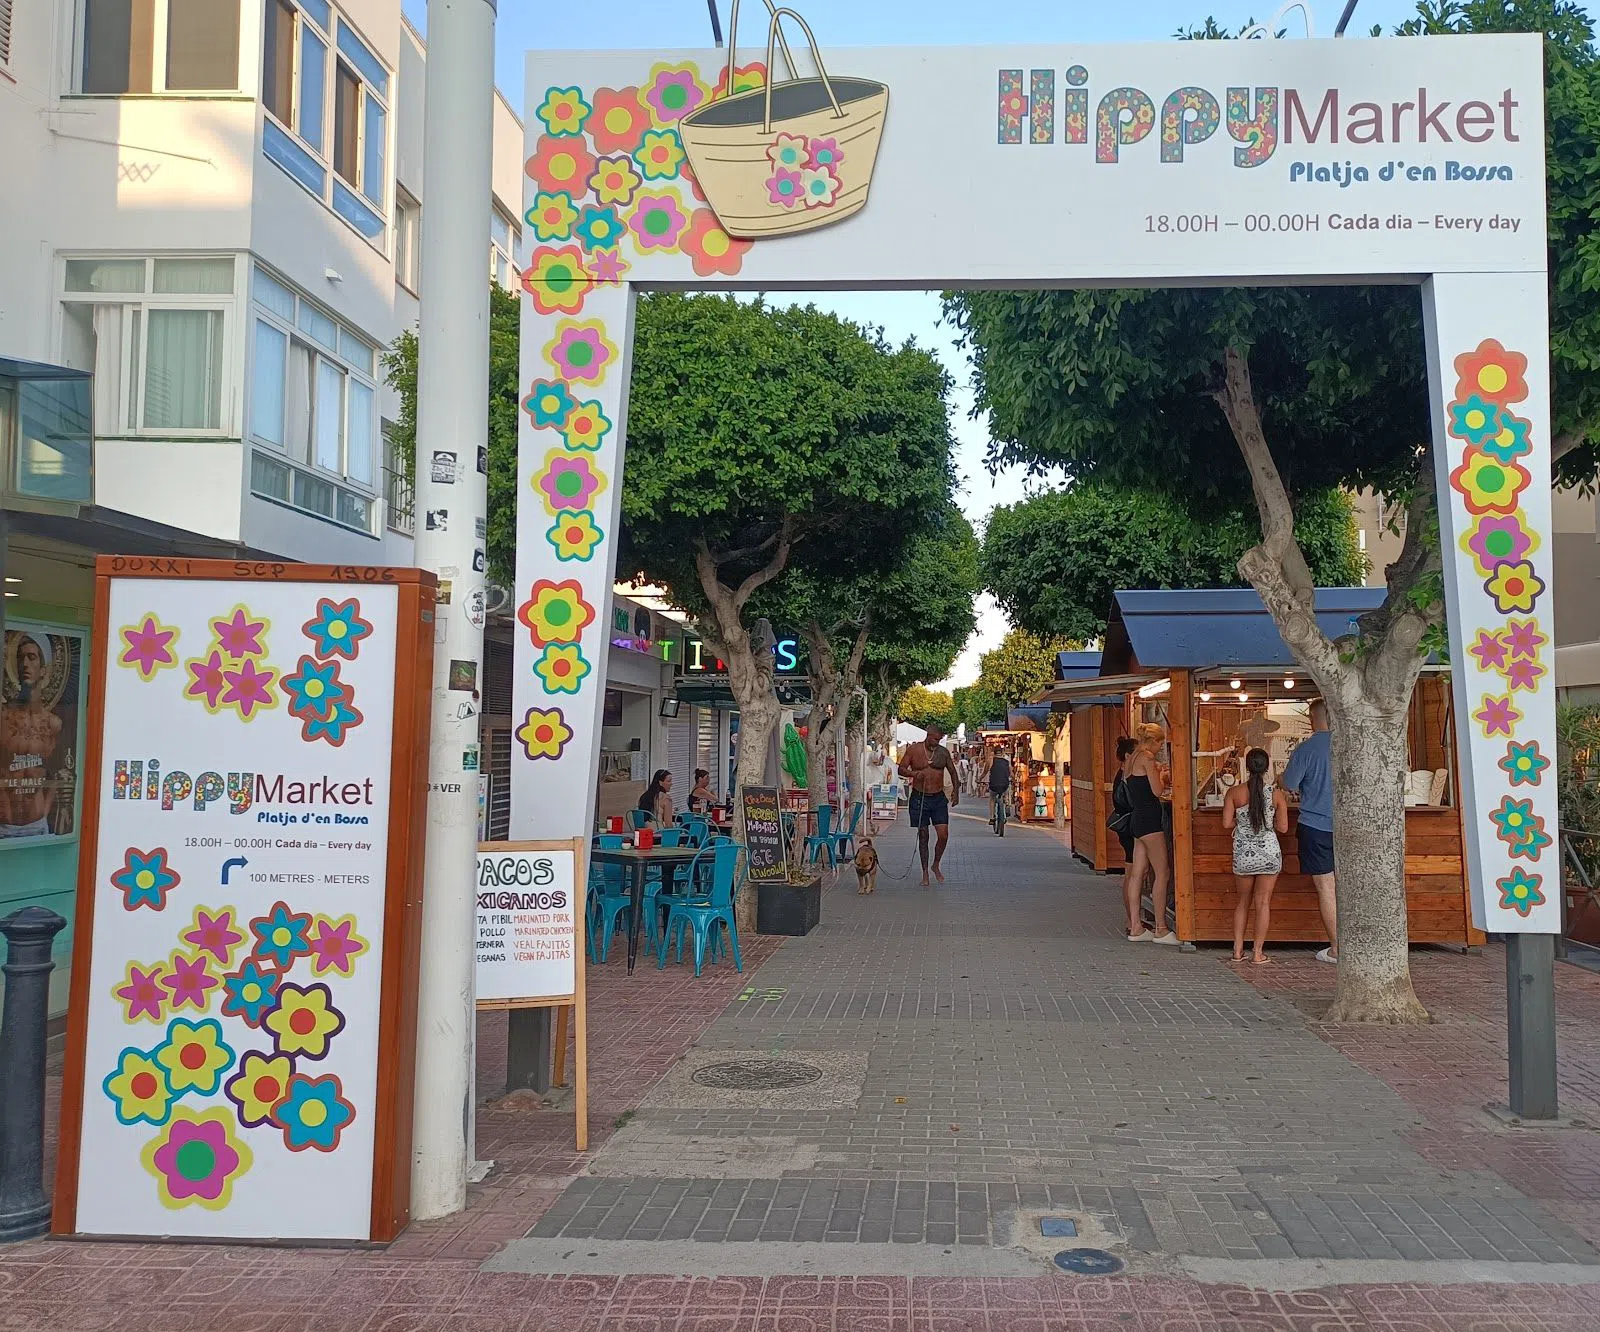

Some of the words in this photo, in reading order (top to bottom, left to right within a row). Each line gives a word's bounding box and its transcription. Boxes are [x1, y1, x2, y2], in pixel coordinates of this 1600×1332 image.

[1289, 161, 1369, 188] Platja
[1378, 161, 1437, 182] d'en
[1445, 161, 1513, 181] Bossa
[1144, 214, 1218, 233] 18.00H
[1243, 213, 1319, 232] 00.00H
[1327, 213, 1380, 230] Cada
[1385, 214, 1412, 230] dia
[1434, 215, 1483, 232] Every
[1488, 214, 1521, 232] day
[233, 562, 285, 578] SCP
[258, 812, 297, 826] Platja
[335, 814, 369, 824] Bossa
[185, 838, 222, 848] 18.00H
[234, 838, 272, 848] 00.00H
[275, 839, 301, 849] Cada
[304, 840, 318, 849] dia
[328, 841, 353, 851] Every
[355, 841, 371, 851] day
[476, 857, 554, 886] ACOS
[250, 873, 267, 882] 100
[270, 873, 315, 883] METRES
[324, 874, 370, 884] METERS
[514, 914, 550, 924] MARINATED
[480, 928, 506, 937] POLLO
[513, 940, 535, 949] VEAL
[537, 940, 570, 950] FAJITAS
[536, 950, 570, 961] FAJITAS
